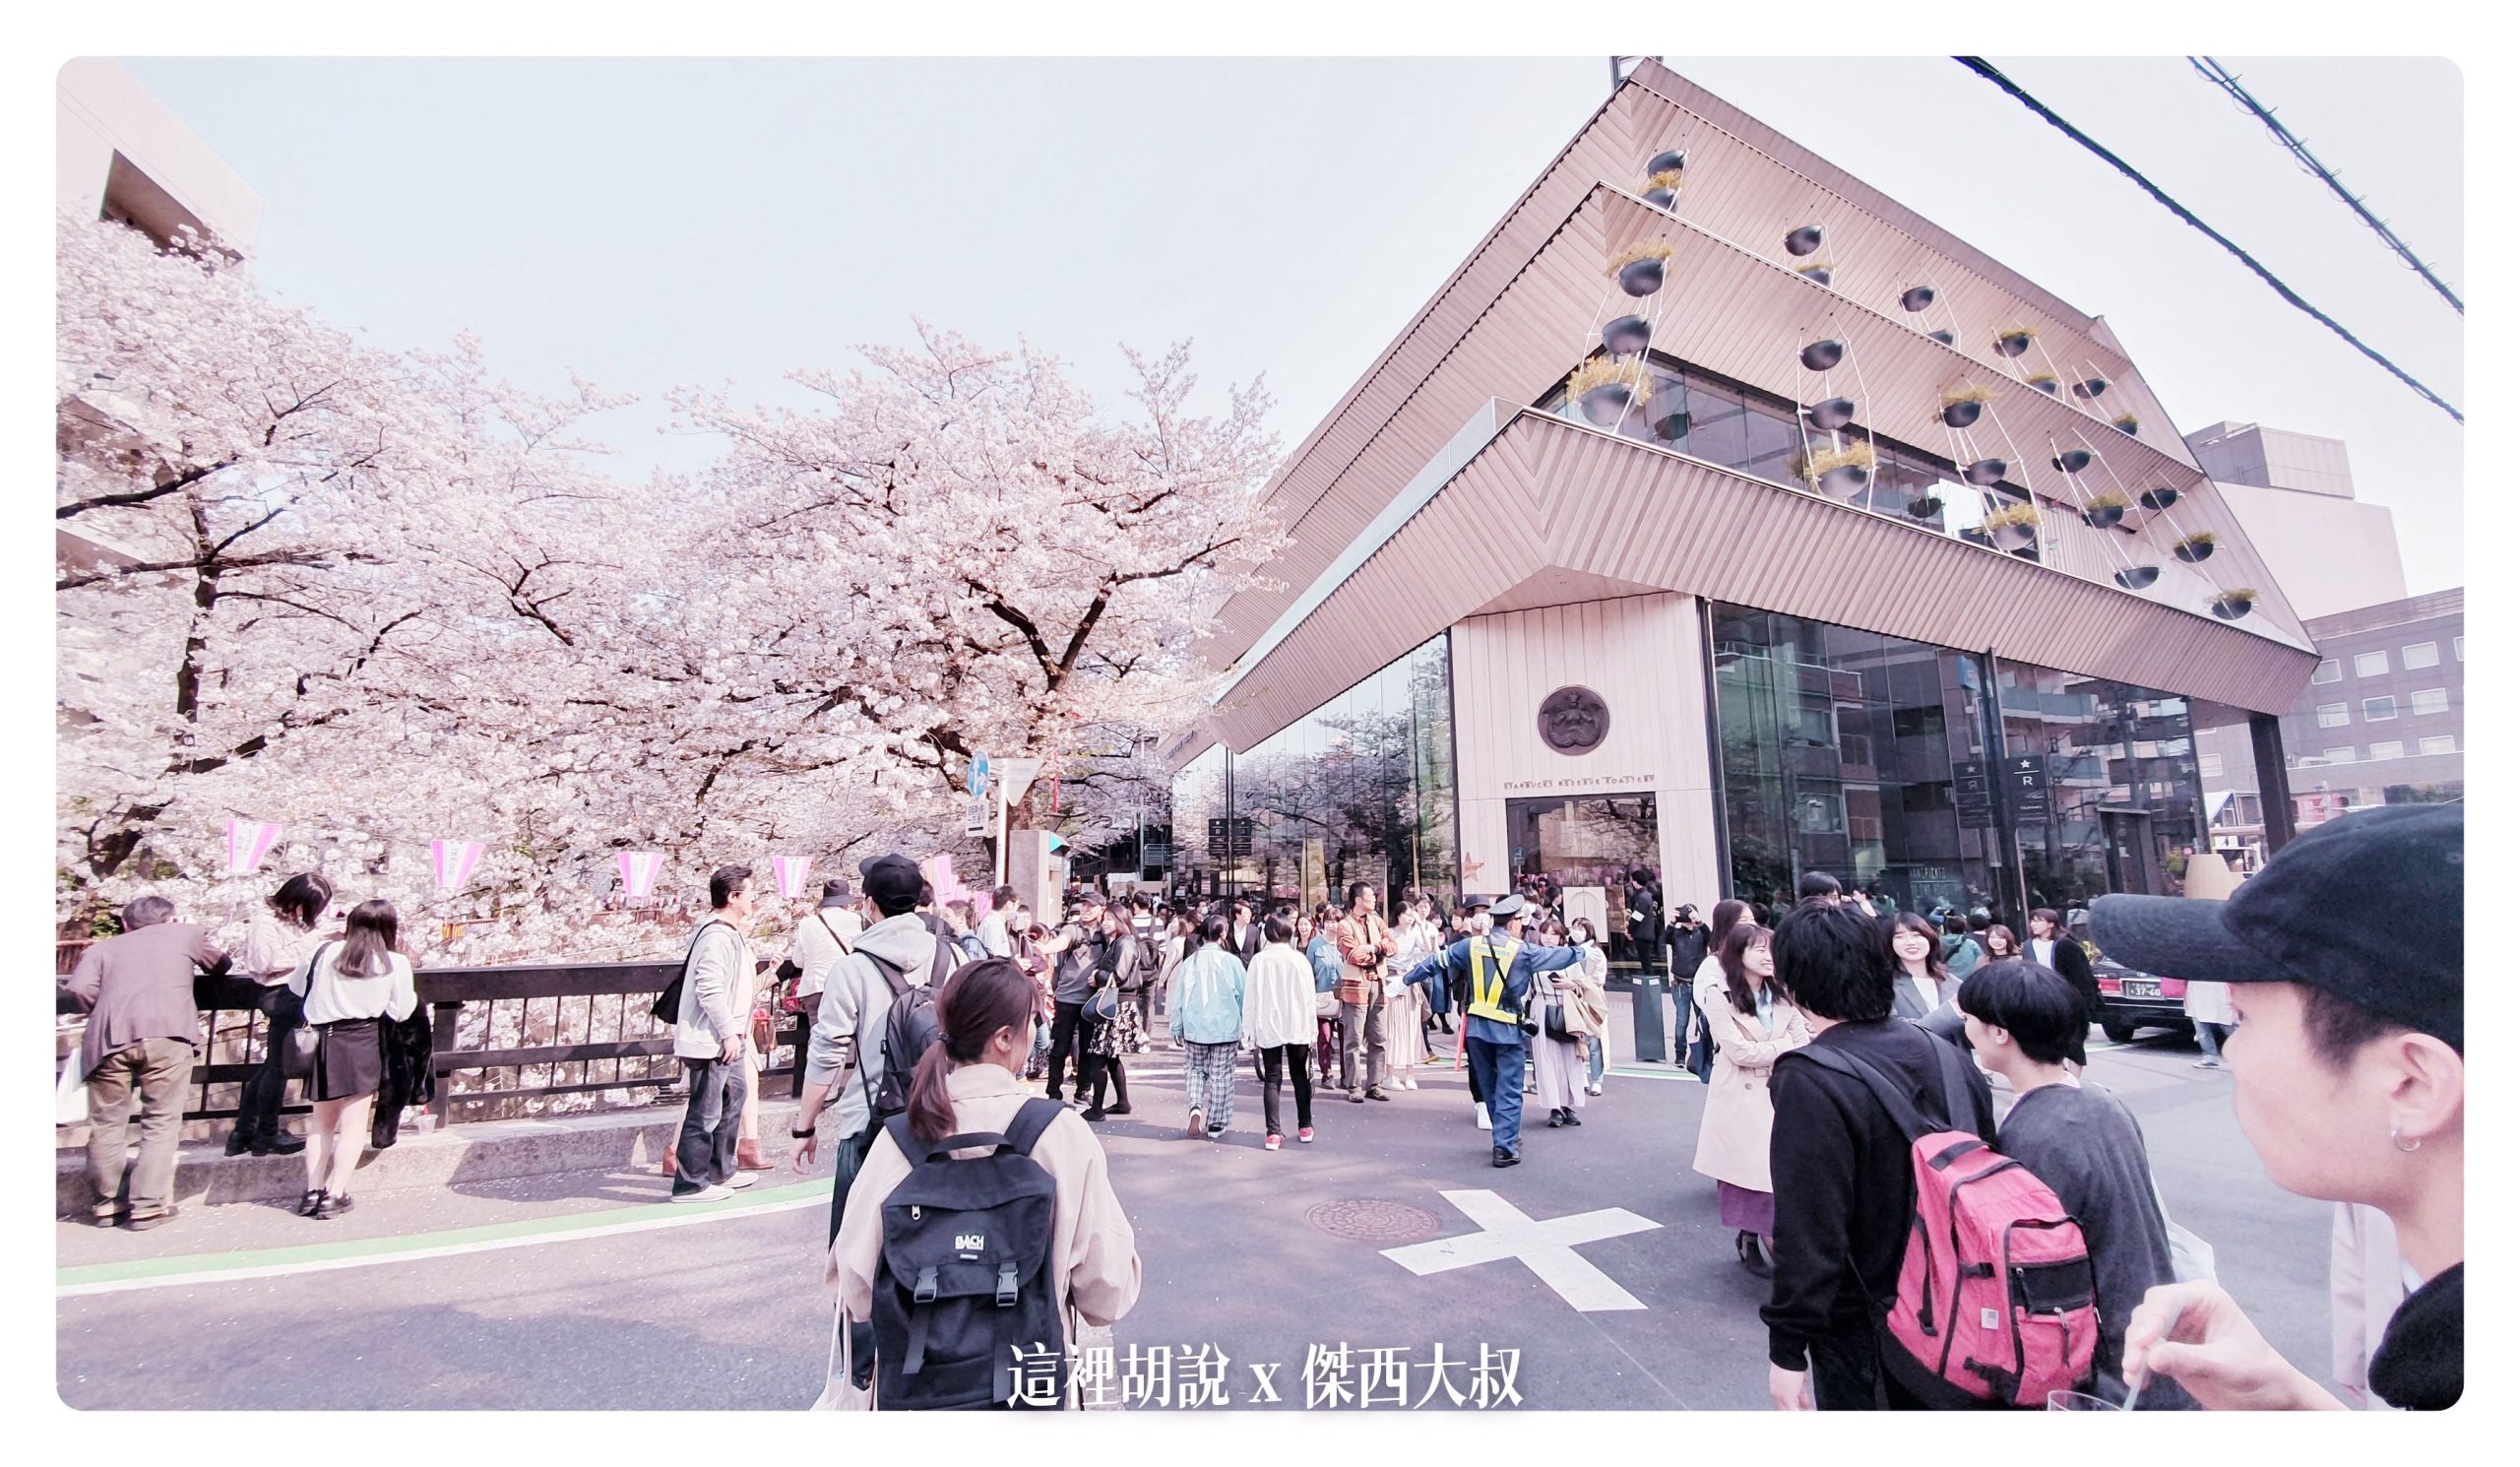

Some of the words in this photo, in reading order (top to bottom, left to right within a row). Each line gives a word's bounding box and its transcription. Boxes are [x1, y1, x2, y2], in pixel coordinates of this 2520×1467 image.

[1503, 780, 1553, 790] STARBUCKS
[1558, 778, 1601, 787] RESERVE
[1604, 774, 1655, 785] ROASTERY
[2023, 776, 2034, 786] R
[955, 1235, 984, 1250] BACH
